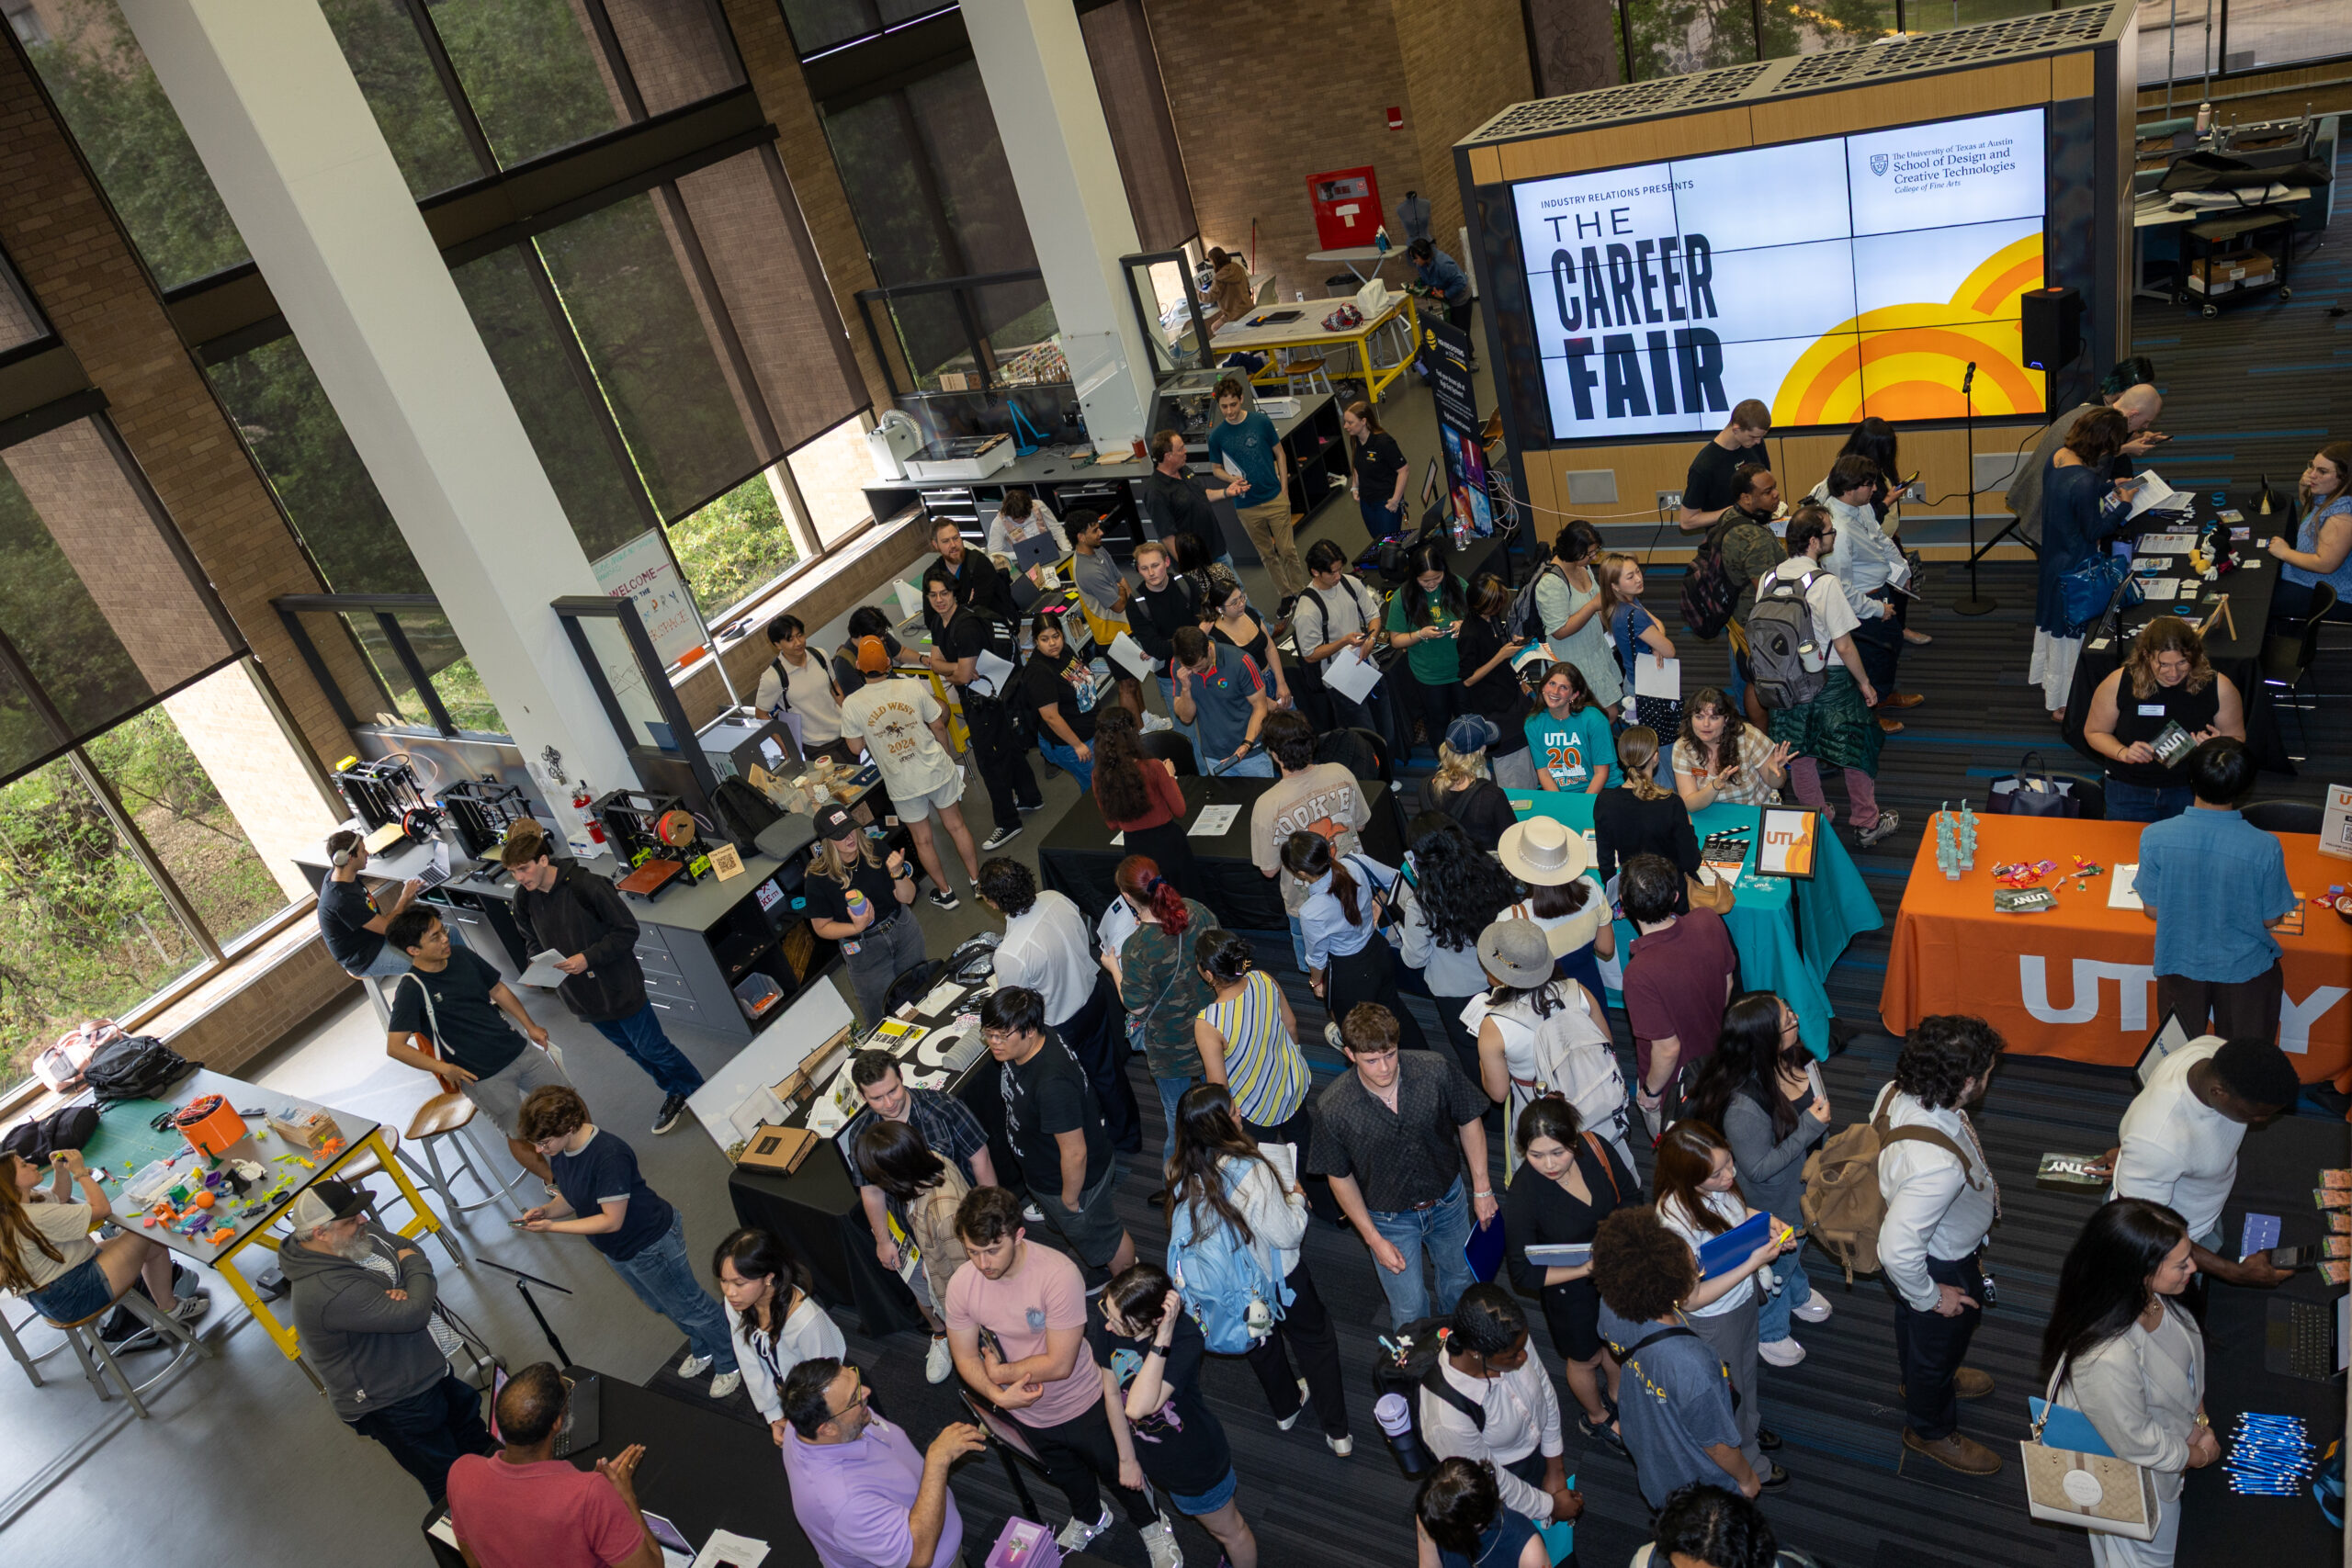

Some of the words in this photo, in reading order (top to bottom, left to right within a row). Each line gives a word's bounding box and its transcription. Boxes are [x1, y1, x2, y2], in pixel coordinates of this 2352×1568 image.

[1892, 152, 1905, 161] The
[1907, 147, 1944, 157] University
[1945, 144, 1954, 154] of
[1955, 142, 1976, 152] Texas
[1978, 141, 1985, 150] at
[1987, 138, 2013, 148] Austin
[1894, 155, 1930, 172] School
[1933, 153, 1945, 167] of
[1947, 152, 1986, 164] Design
[1989, 147, 2010, 159] and
[1894, 169, 1939, 185] Creative
[1942, 162, 2016, 177] Technologies
[1541, 195, 1586, 209] INDUSTRY
[1589, 187, 1640, 202] RELATIONS
[1643, 180, 1694, 195] PRESENTS
[1894, 184, 1919, 194] College
[1920, 182, 1928, 192] of
[1929, 181, 1945, 190] Fine
[1946, 179, 1962, 188] Arts
[1544, 207, 1634, 243] THE
[1551, 233, 1718, 332] CAREER
[1563, 327, 1730, 421] FAIR
[609, 567, 658, 597] WELCOME
[639, 588, 651, 597] THE
[649, 608, 690, 643] ERSPACE
[867, 705, 887, 727] WILD
[887, 701, 915, 716] WEST
[888, 737, 916, 753] 2024
[1544, 732, 1581, 746] UTLA
[2155, 732, 2185, 760] UTNY
[1546, 747, 1581, 768] 20
[1767, 831, 1810, 846] UTLA
[2013, 893, 2049, 906] UTNY
[2019, 954, 2351, 1055] UTY
